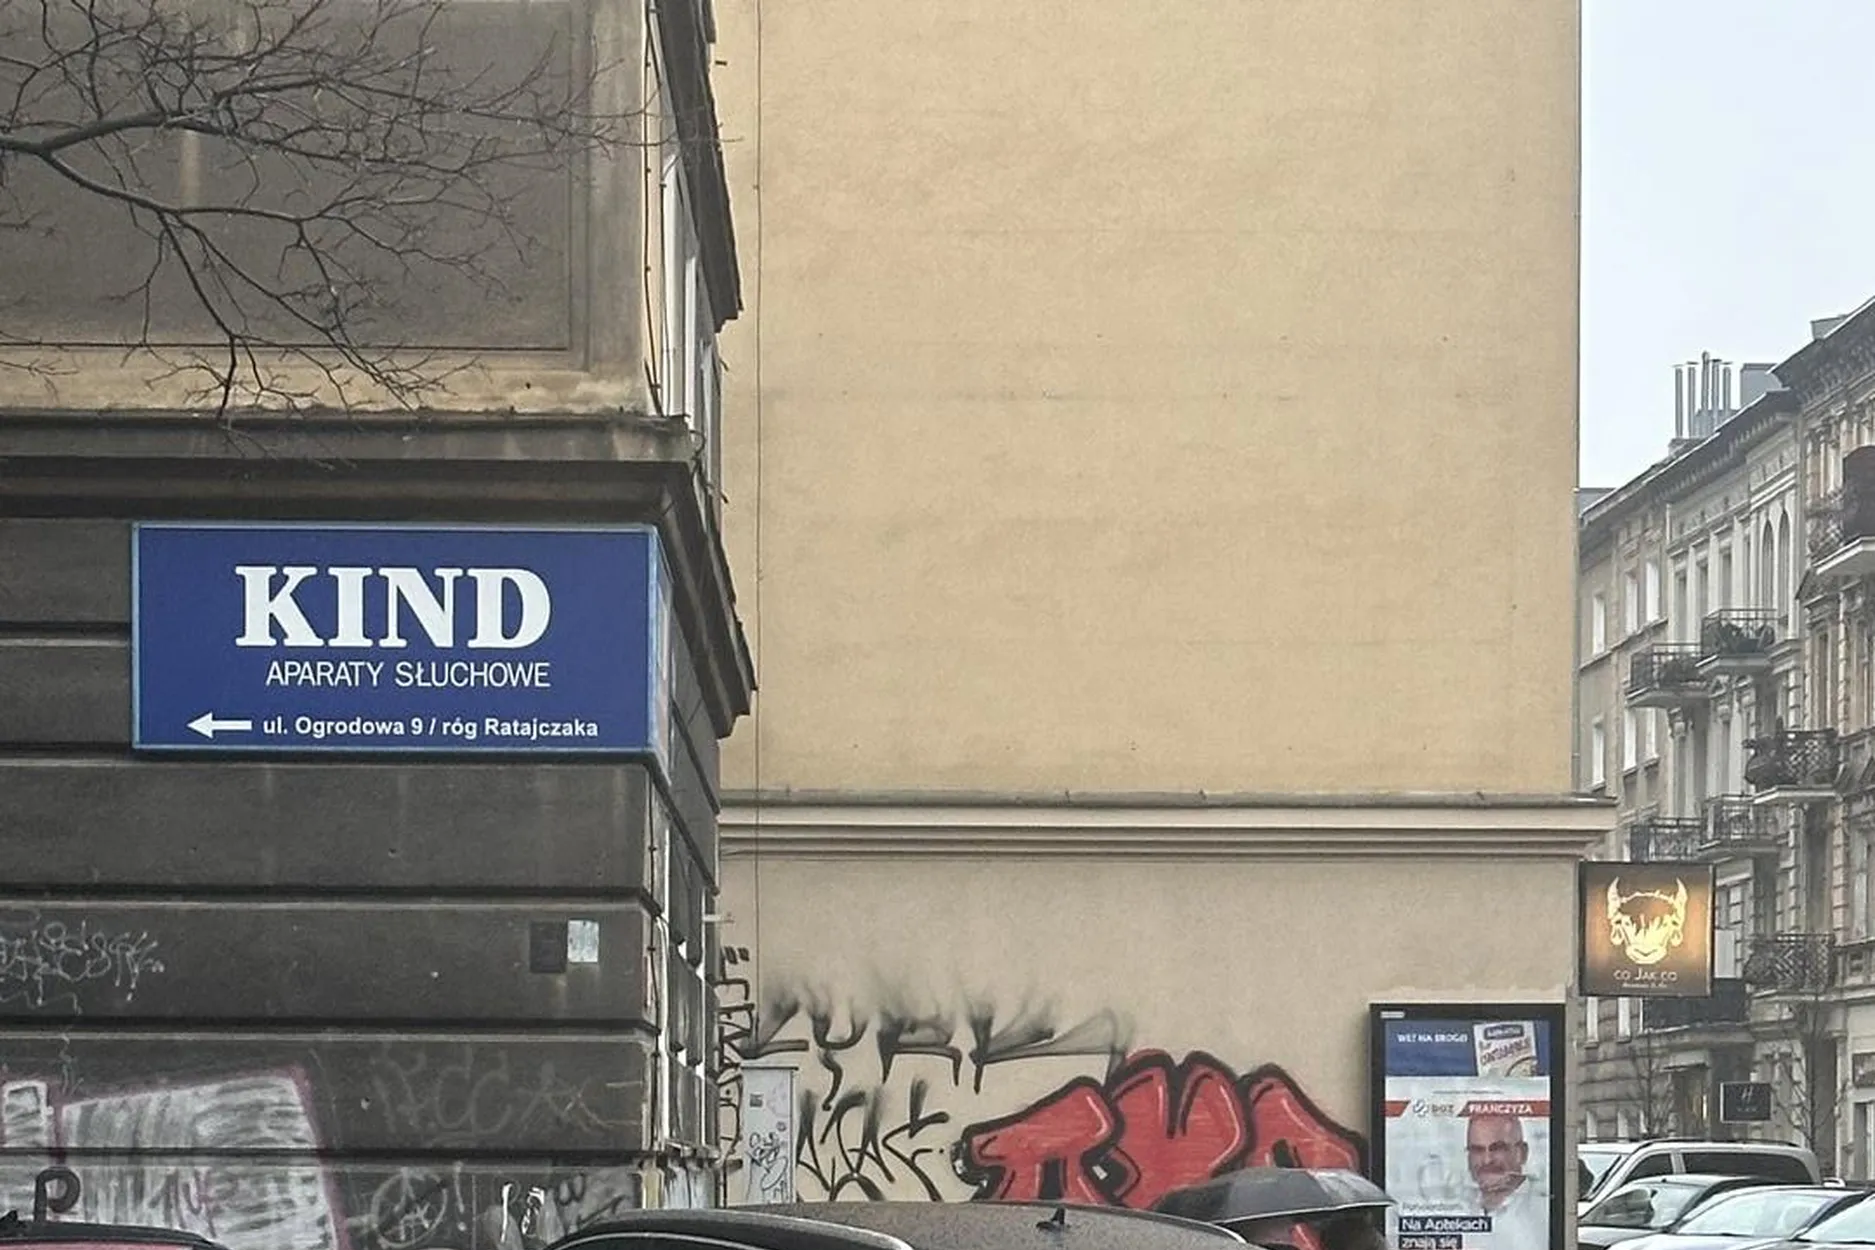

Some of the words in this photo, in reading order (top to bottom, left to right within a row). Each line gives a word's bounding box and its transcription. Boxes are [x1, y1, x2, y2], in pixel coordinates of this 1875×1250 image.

[235, 565, 552, 649] KIND
[266, 661, 383, 688] APARATY
[395, 660, 552, 688] SŁUCHOWE
[264, 717, 288, 736] ul.
[295, 717, 406, 739] Ogrodowa
[411, 717, 423, 735] 9
[428, 717, 437, 736] /
[442, 717, 478, 740] róg
[484, 718, 598, 739] Ratajczaka
[1402, 1218, 1421, 1231] Na
[1424, 1218, 1488, 1232] Aptekach
